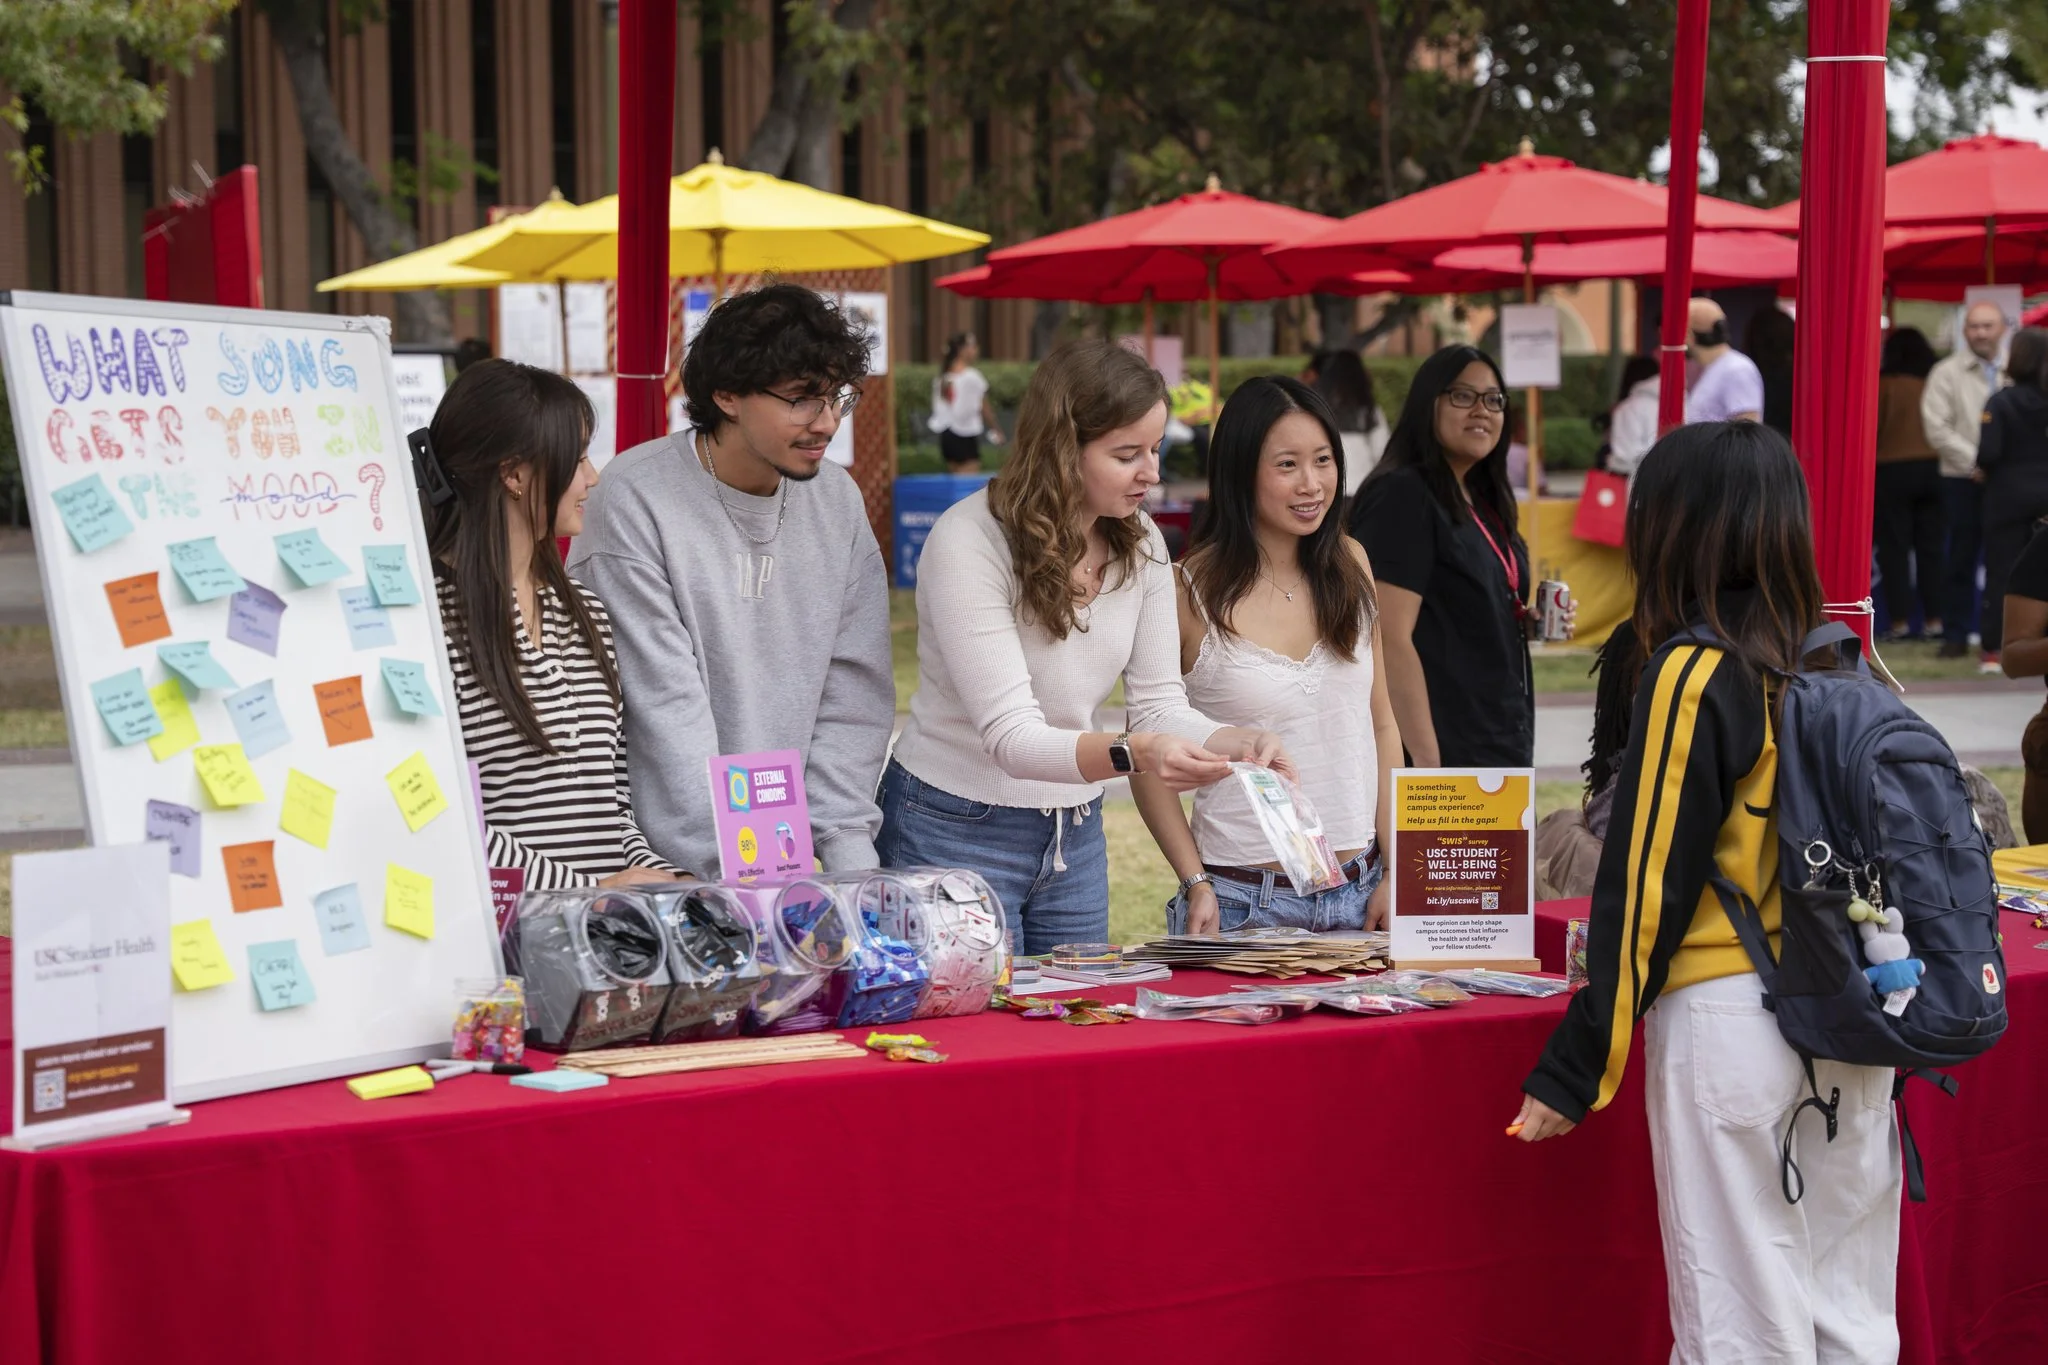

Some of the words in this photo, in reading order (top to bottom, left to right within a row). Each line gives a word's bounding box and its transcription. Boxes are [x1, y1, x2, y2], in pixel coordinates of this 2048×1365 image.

[33, 323, 189, 404] WHAT
[217, 331, 357, 396] SONG
[46, 404, 185, 465] GETS
[206, 406, 300, 459] YOU
[317, 404, 383, 456] IN
[118, 472, 200, 519] THE
[228, 472, 339, 520] MOOD
[754, 770, 787, 786] EXTERNAL
[1416, 784, 1456, 793] something
[757, 787, 786, 804] CONDOMS
[1407, 794, 1437, 802] missing
[1407, 804, 1436, 812] campus
[1439, 804, 1484, 812] experience?
[1407, 817, 1425, 825] Help
[1438, 816, 1449, 824] fill
[1476, 817, 1498, 825] gaps!
[1427, 848, 1448, 858] USC
[1450, 848, 1498, 857] STUDENT
[1428, 860, 1497, 869] WELL-BEING
[1427, 897, 1479, 906] bit.ly/uscswis
[115, 937, 156, 957] Health
